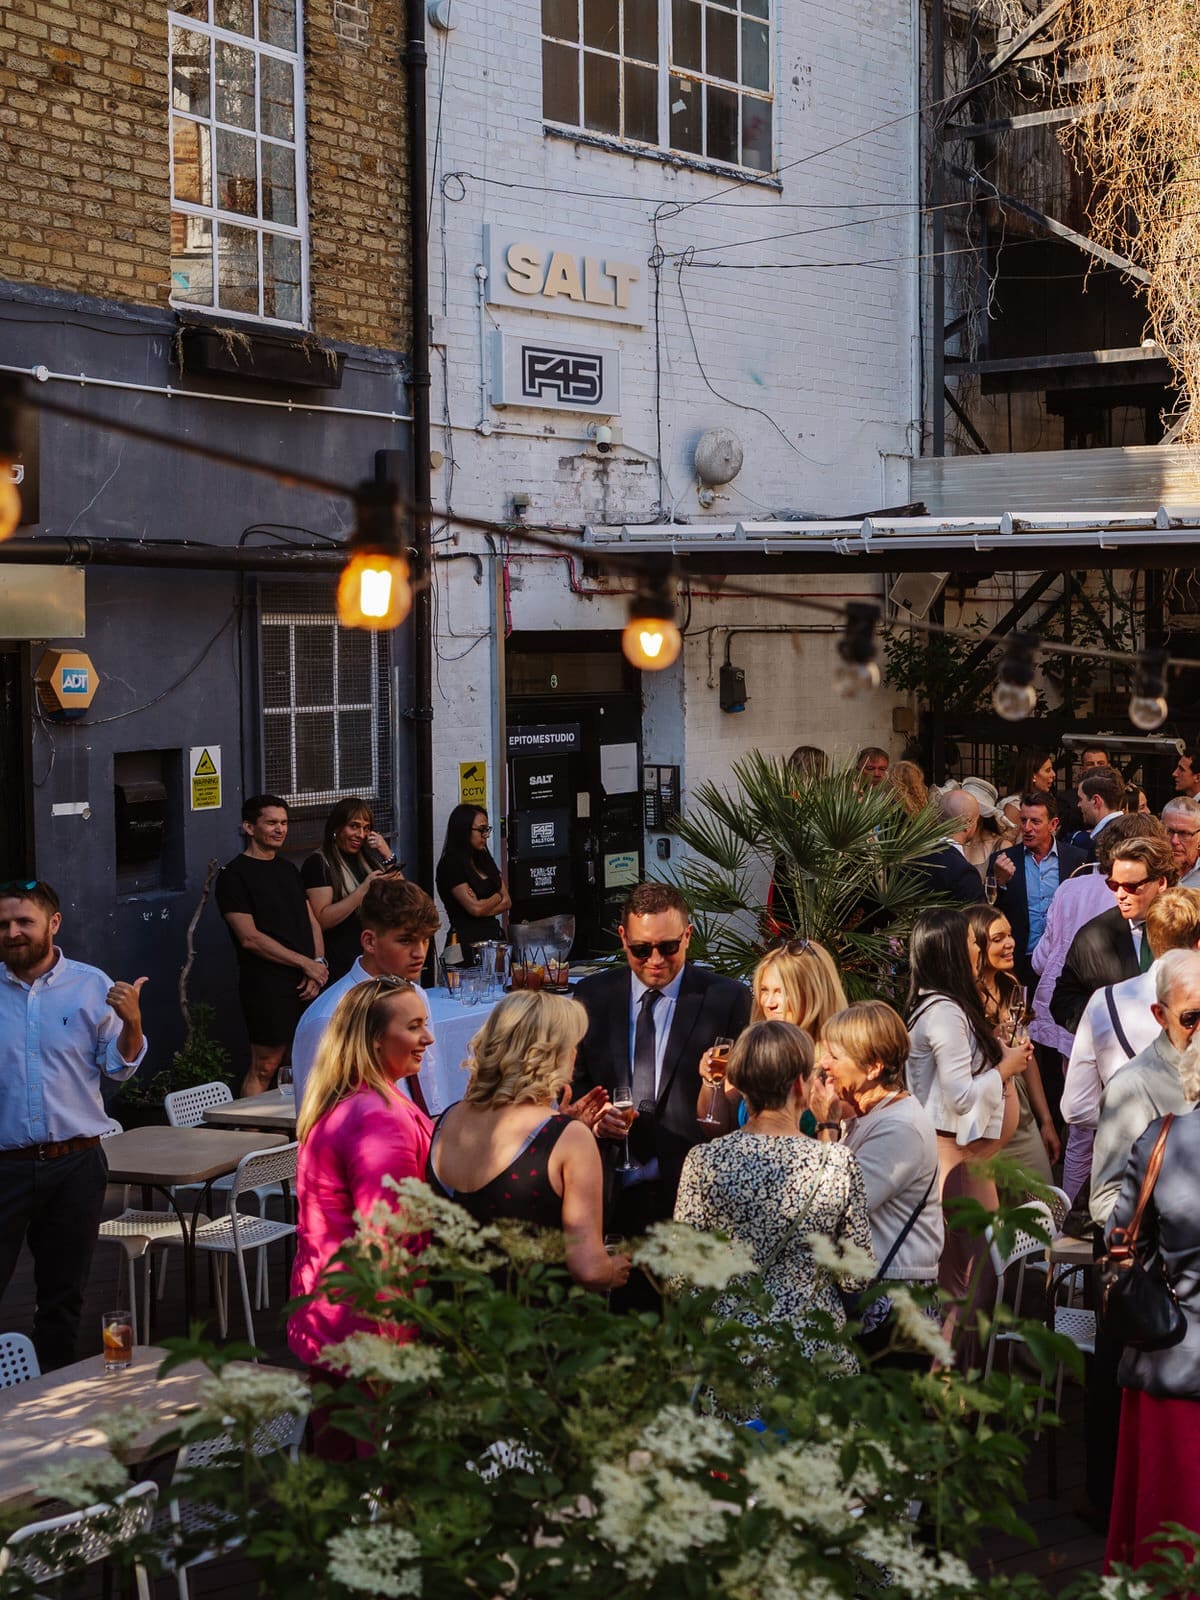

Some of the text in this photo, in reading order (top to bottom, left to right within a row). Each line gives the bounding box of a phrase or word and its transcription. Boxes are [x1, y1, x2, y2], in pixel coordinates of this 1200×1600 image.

[505, 243, 641, 309] SALT
[522, 345, 603, 405] F45
[63, 674, 88, 689] ADT
[509, 732, 575, 746] EPITOMESTUDIO
[529, 774, 554, 786] SALT
[462, 787, 485, 797] CCTV
[531, 822, 554, 838] F45
[531, 836, 555, 845] DALSTON
